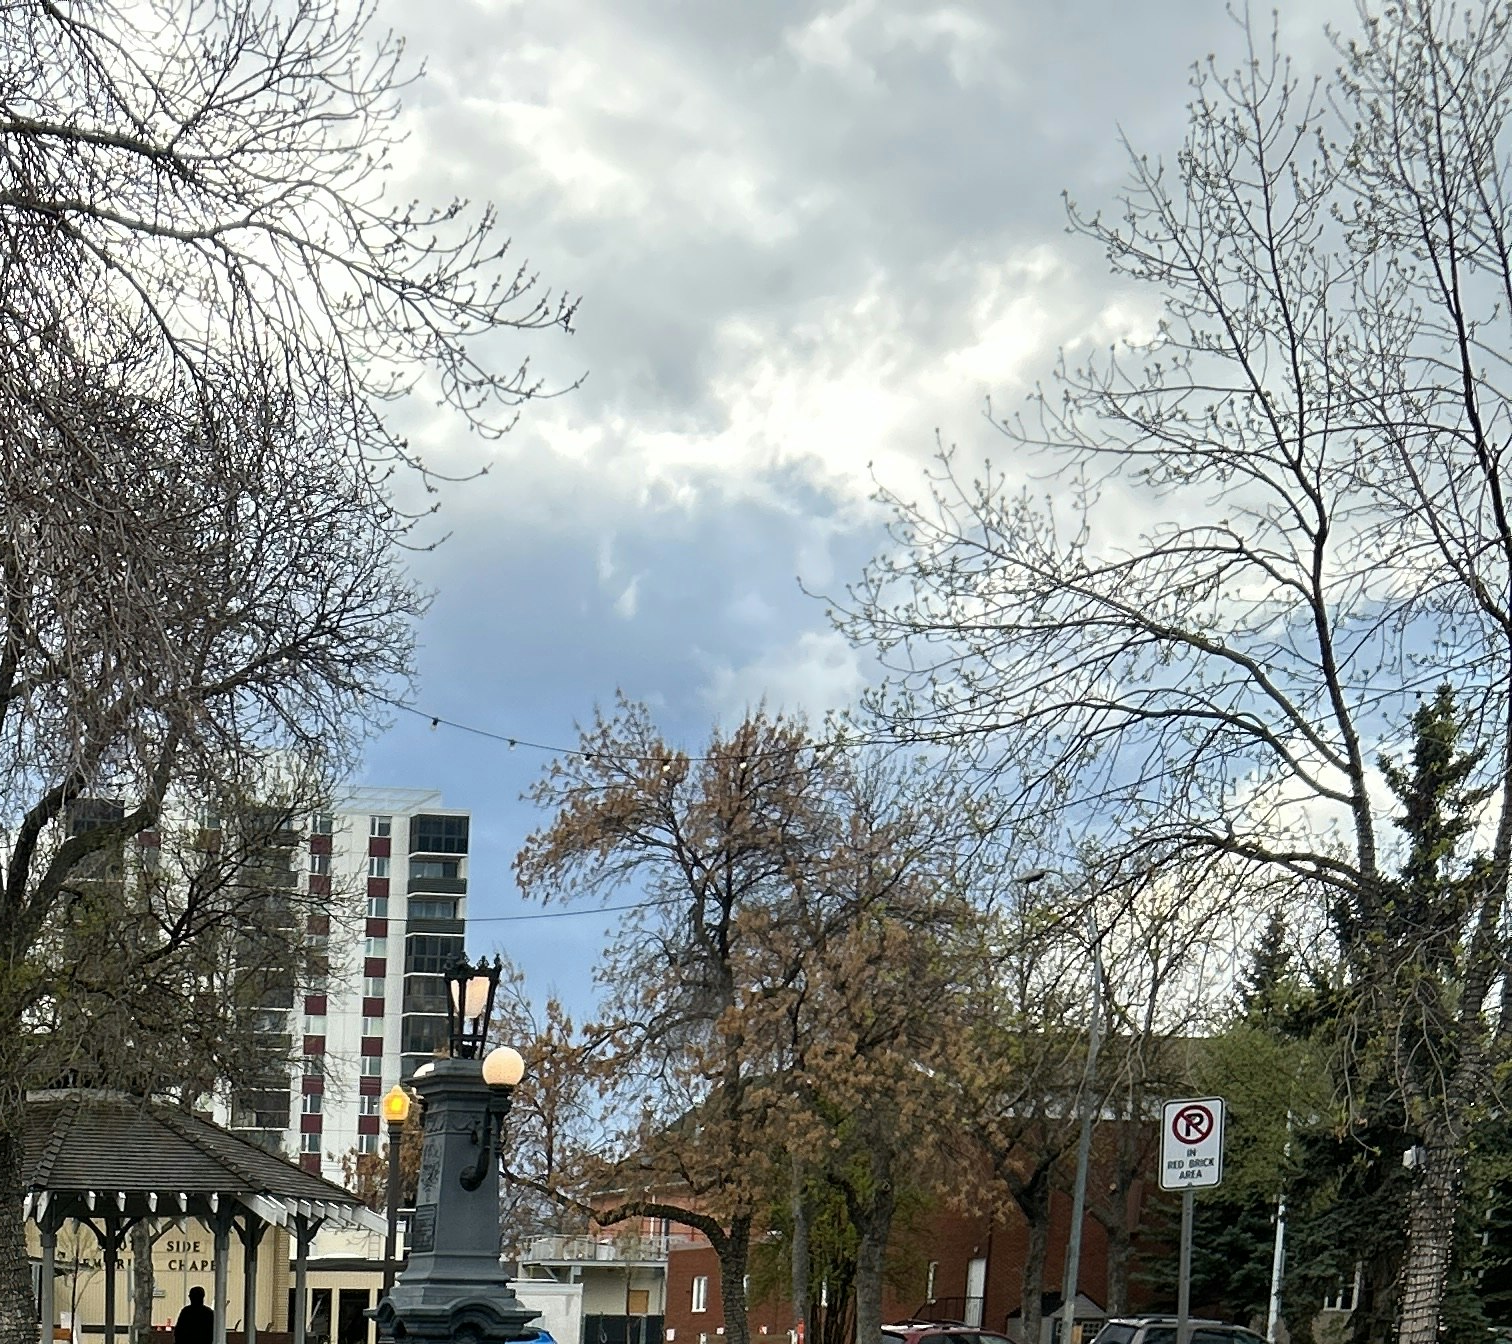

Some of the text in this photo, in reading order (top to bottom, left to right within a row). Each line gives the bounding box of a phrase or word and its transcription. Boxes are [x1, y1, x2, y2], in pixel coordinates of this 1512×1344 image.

[1187, 1148, 1196, 1157] IN
[1168, 1158, 1214, 1169] RED BRICK
[1179, 1170, 1202, 1179] AREA
[167, 1259, 216, 1272] CHAPE
